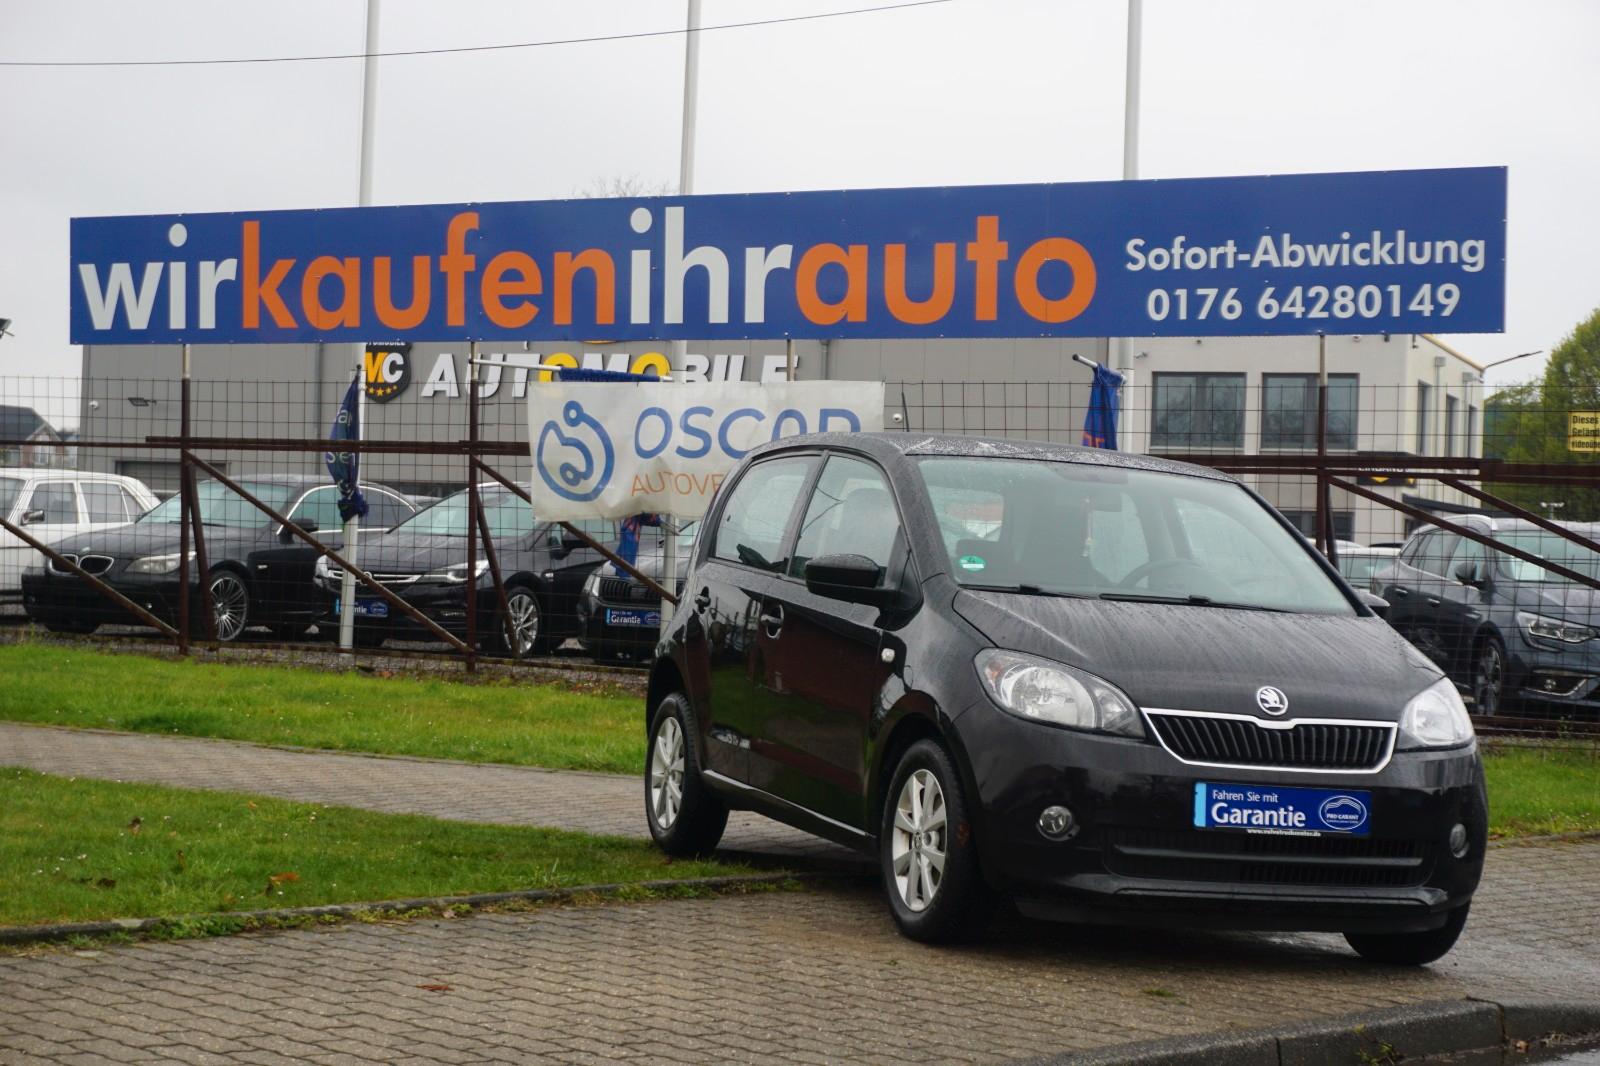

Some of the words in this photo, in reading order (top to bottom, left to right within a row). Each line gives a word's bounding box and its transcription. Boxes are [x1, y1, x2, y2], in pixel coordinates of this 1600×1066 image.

[1125, 230, 1486, 273] Sofort-Abwicklung
[1147, 287, 1243, 321] 0176
[1257, 283, 1461, 320] 64280149
[1212, 789, 1244, 801] Fahren
[1247, 791, 1261, 802] Sie
[1263, 793, 1279, 803] mit
[1211, 802, 1306, 827] Garantie
